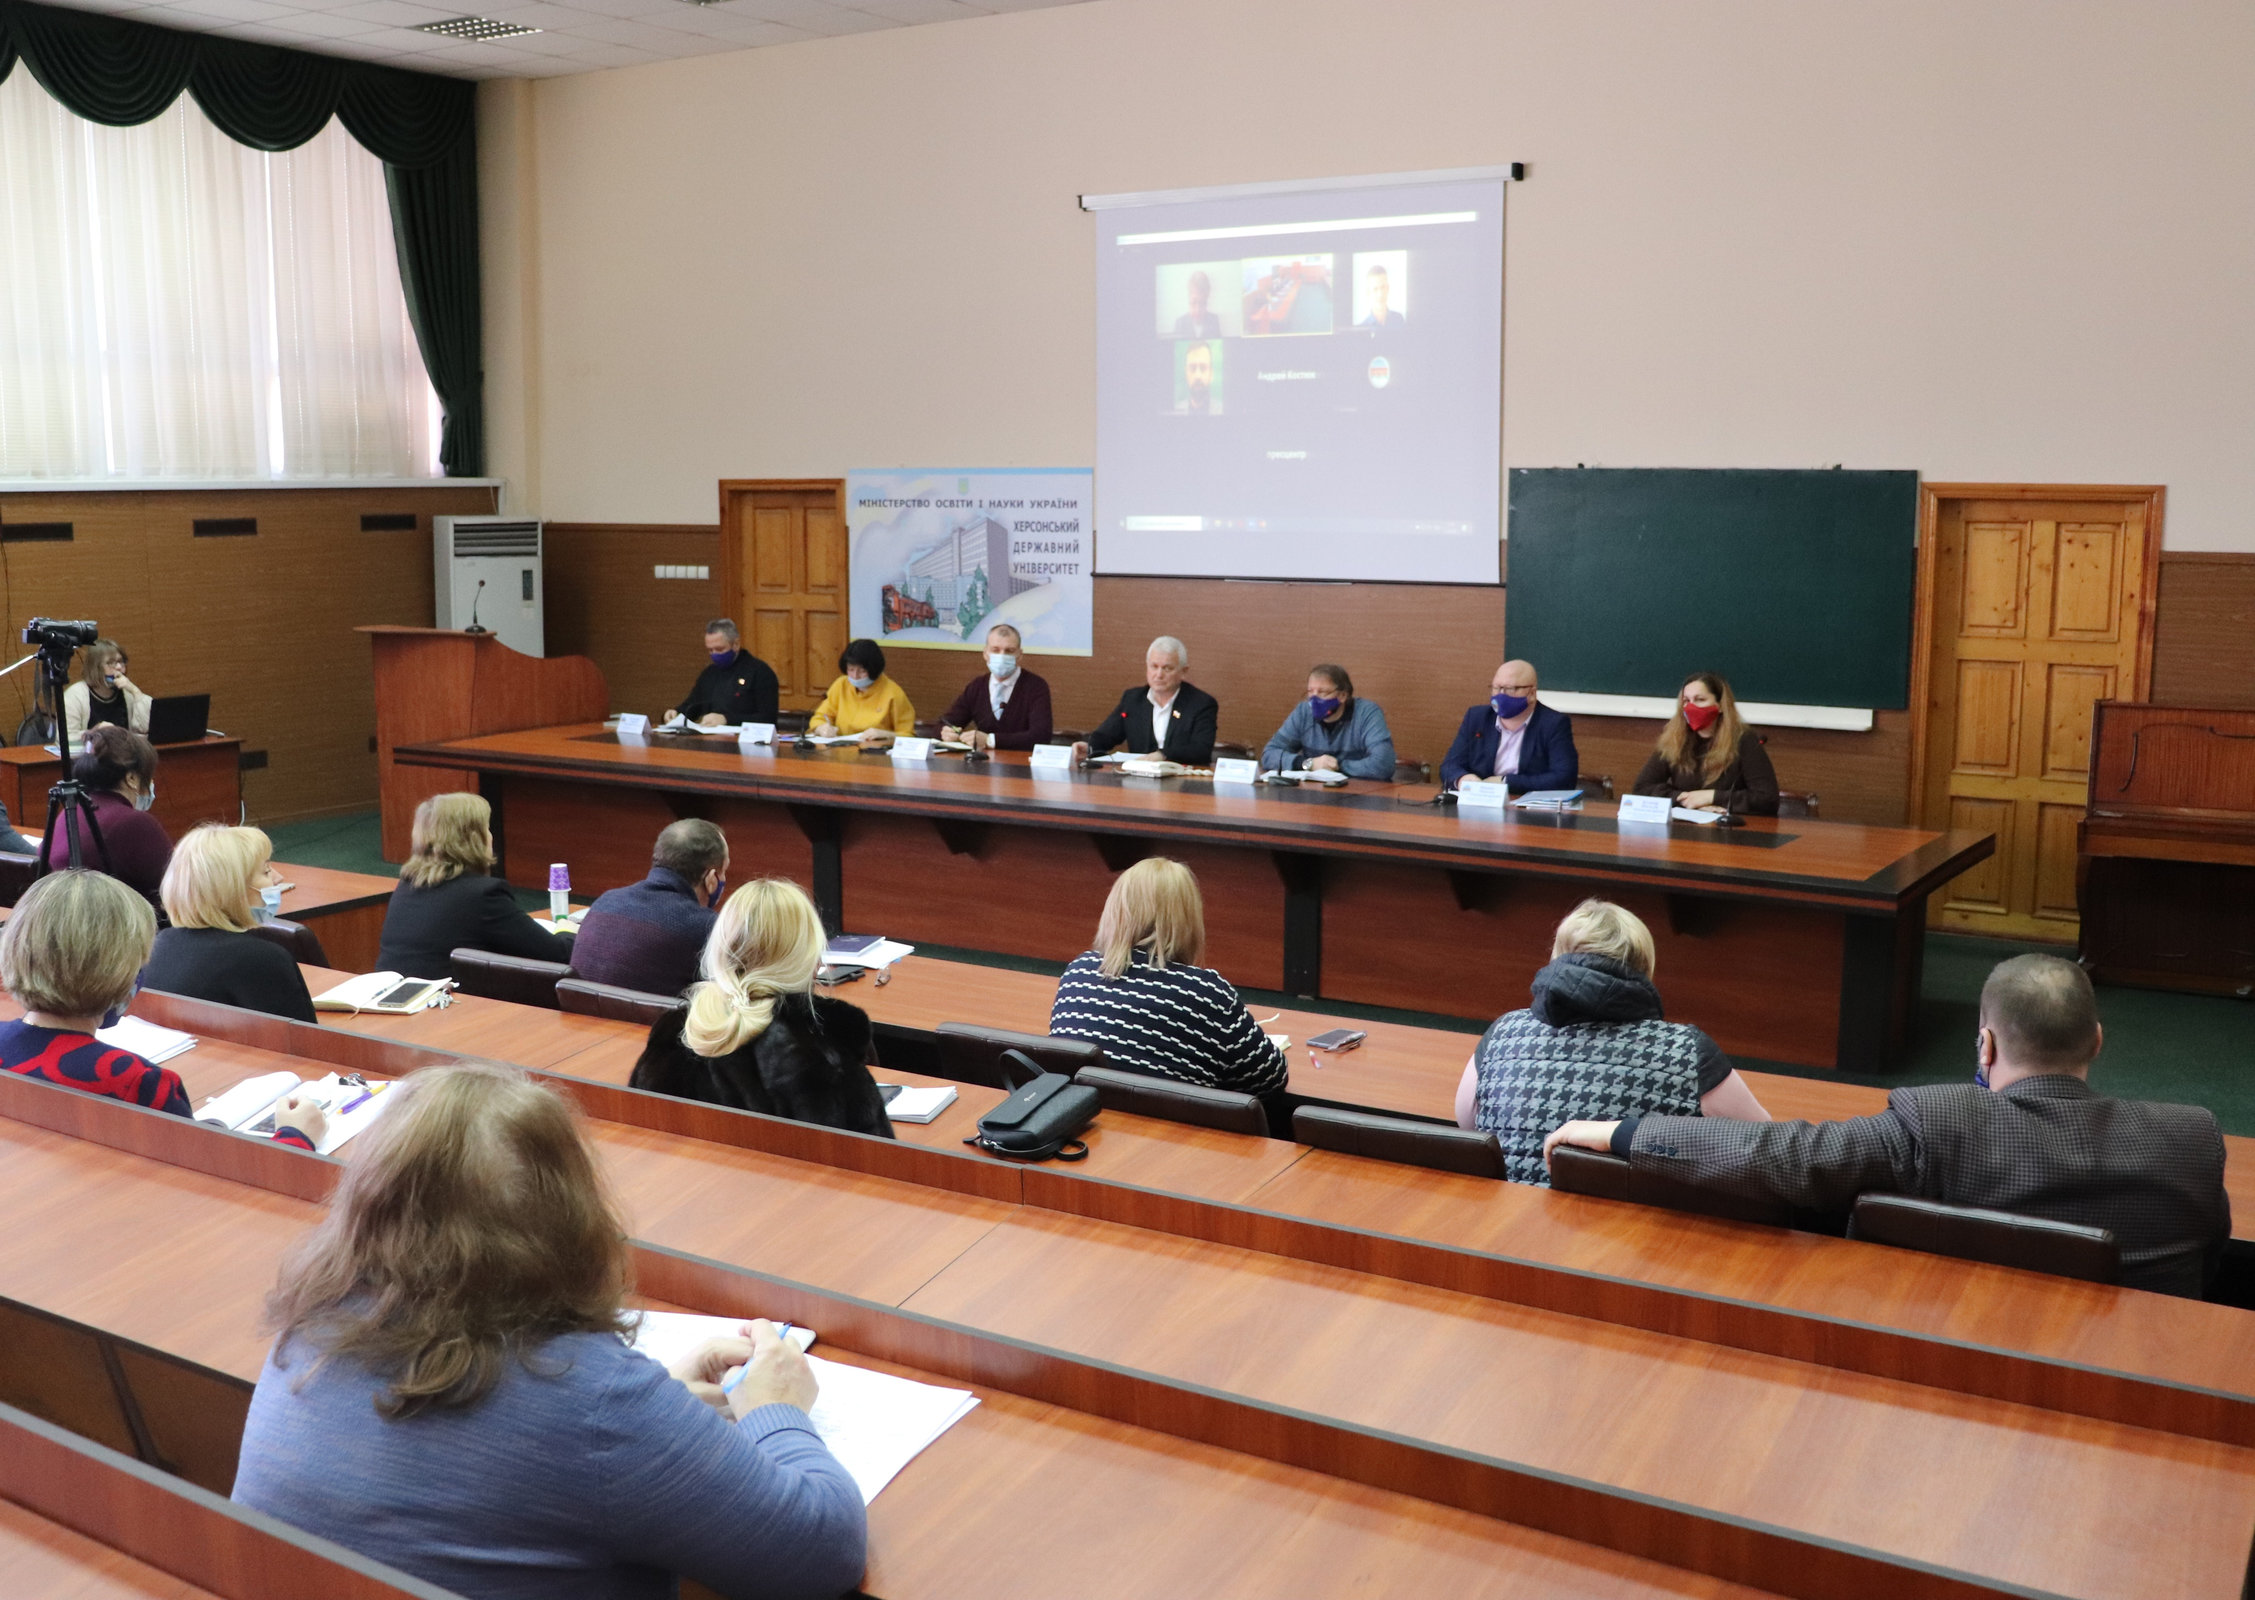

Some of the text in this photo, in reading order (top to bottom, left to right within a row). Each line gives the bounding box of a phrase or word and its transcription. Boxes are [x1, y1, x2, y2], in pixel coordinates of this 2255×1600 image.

[858, 498, 1078, 509] МІНІСТЕРСТВО ОСВІТИ І НАУКИ УКРАЇНИ
[1013, 518, 1079, 533] ХЕРСОНСЬКИЙ
[1013, 539, 1079, 555] ДЕРЖАВНИЙ
[1013, 562, 1079, 575] УНІВЕРСИТЕТ
